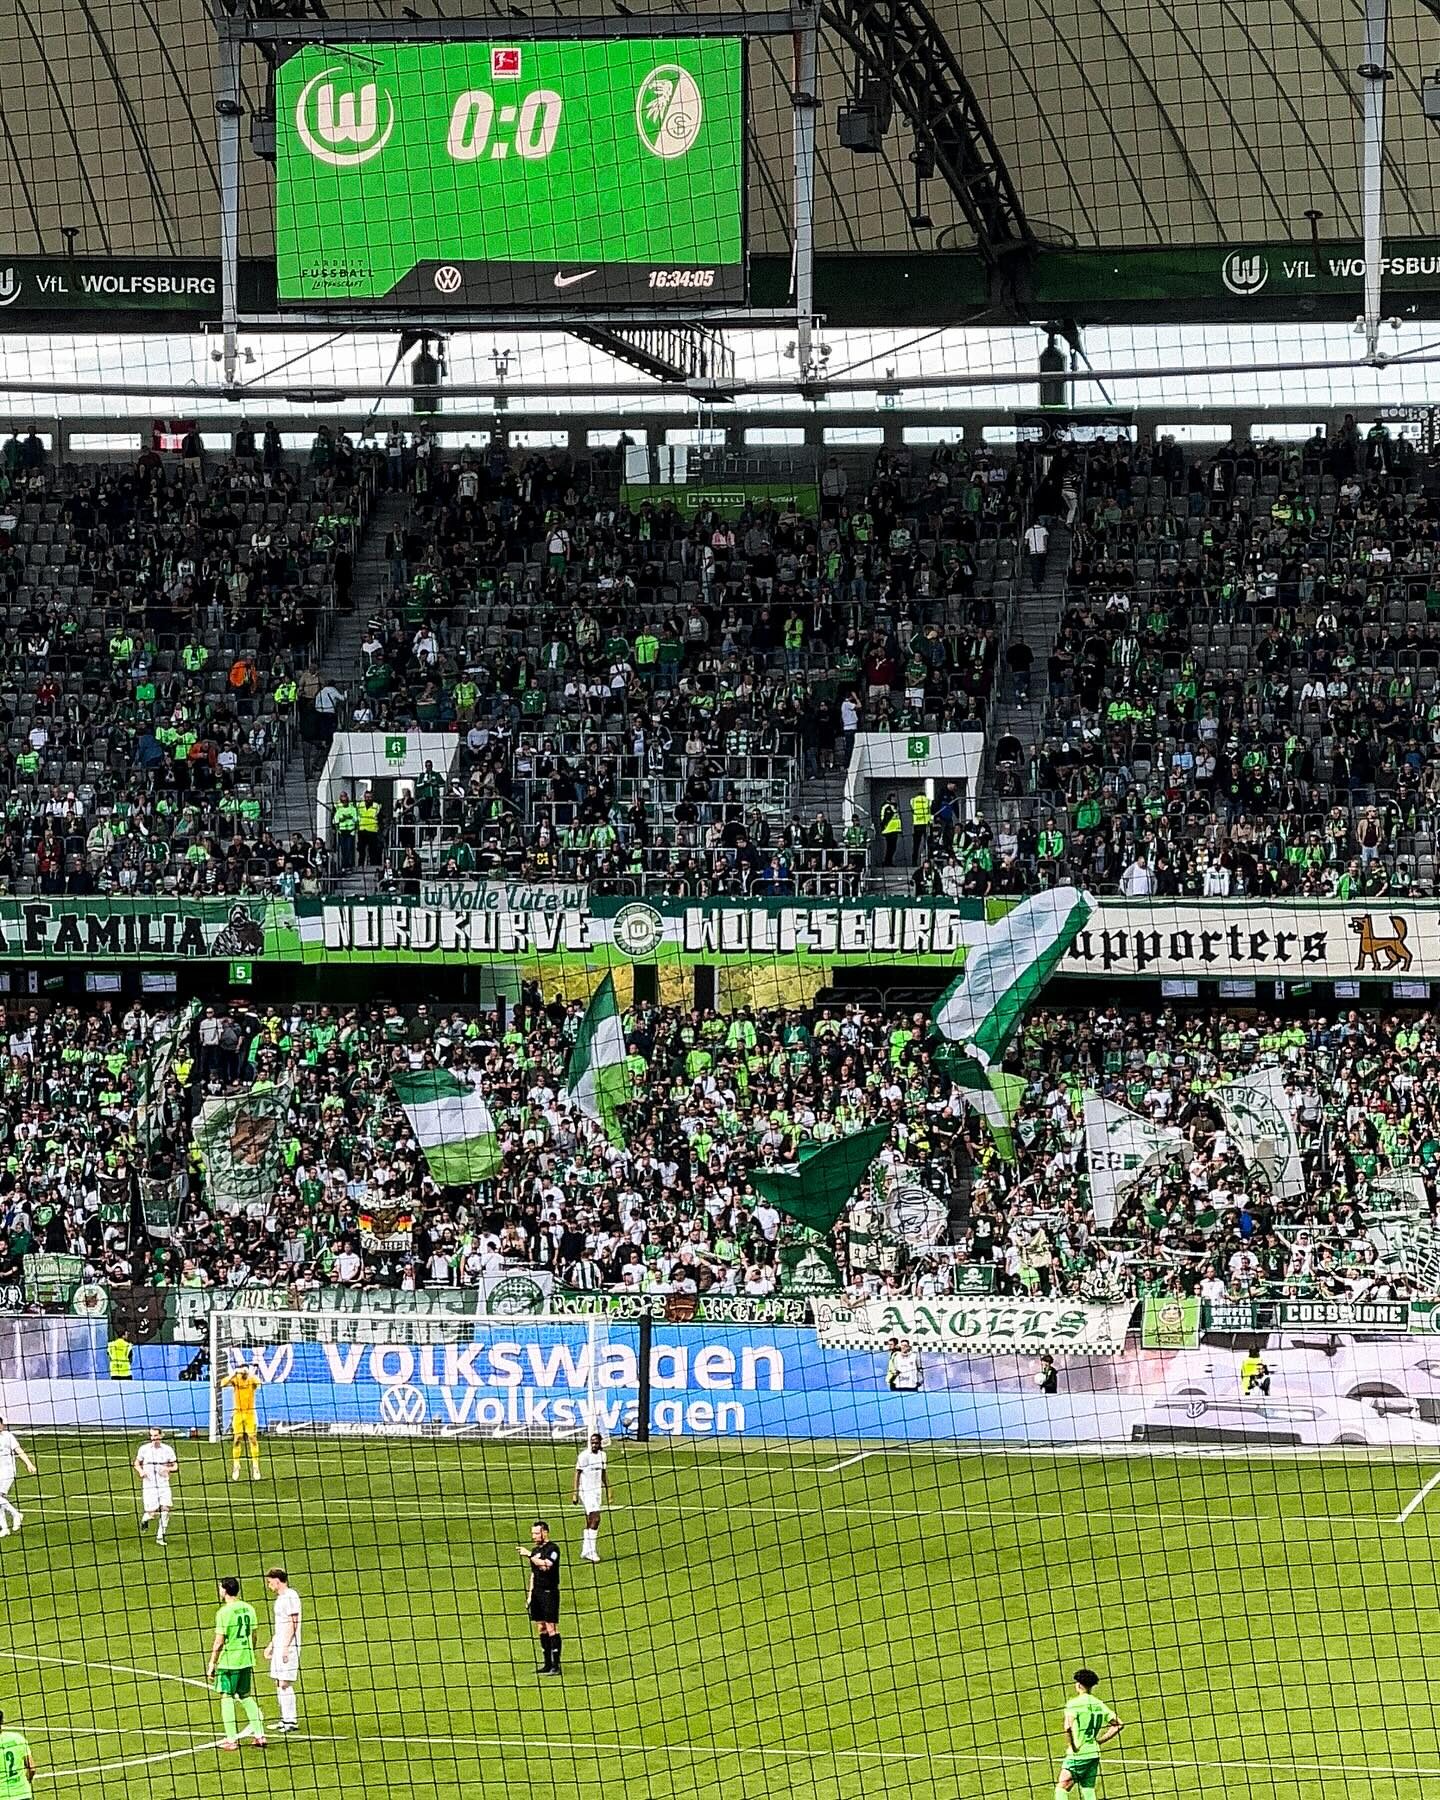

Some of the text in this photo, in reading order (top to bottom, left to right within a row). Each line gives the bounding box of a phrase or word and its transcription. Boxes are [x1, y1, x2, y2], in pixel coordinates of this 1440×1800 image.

[447, 90, 562, 160] 0:0
[36, 275, 216, 294] VfL WOLFSBURG
[302, 268, 375, 278] FUSSBALL
[649, 270, 714, 288] 16:34:05
[1283, 260, 1316, 279] VfL
[445, 881, 500, 911] Volle
[22, 903, 210, 956] FAMILIA
[325, 906, 595, 954] NORDKURVE
[683, 907, 961, 954] WOLFSBURG
[1067, 923, 1328, 972] upporters
[236, 966, 246, 979] 5
[877, 1306, 1089, 1339] ANGELS
